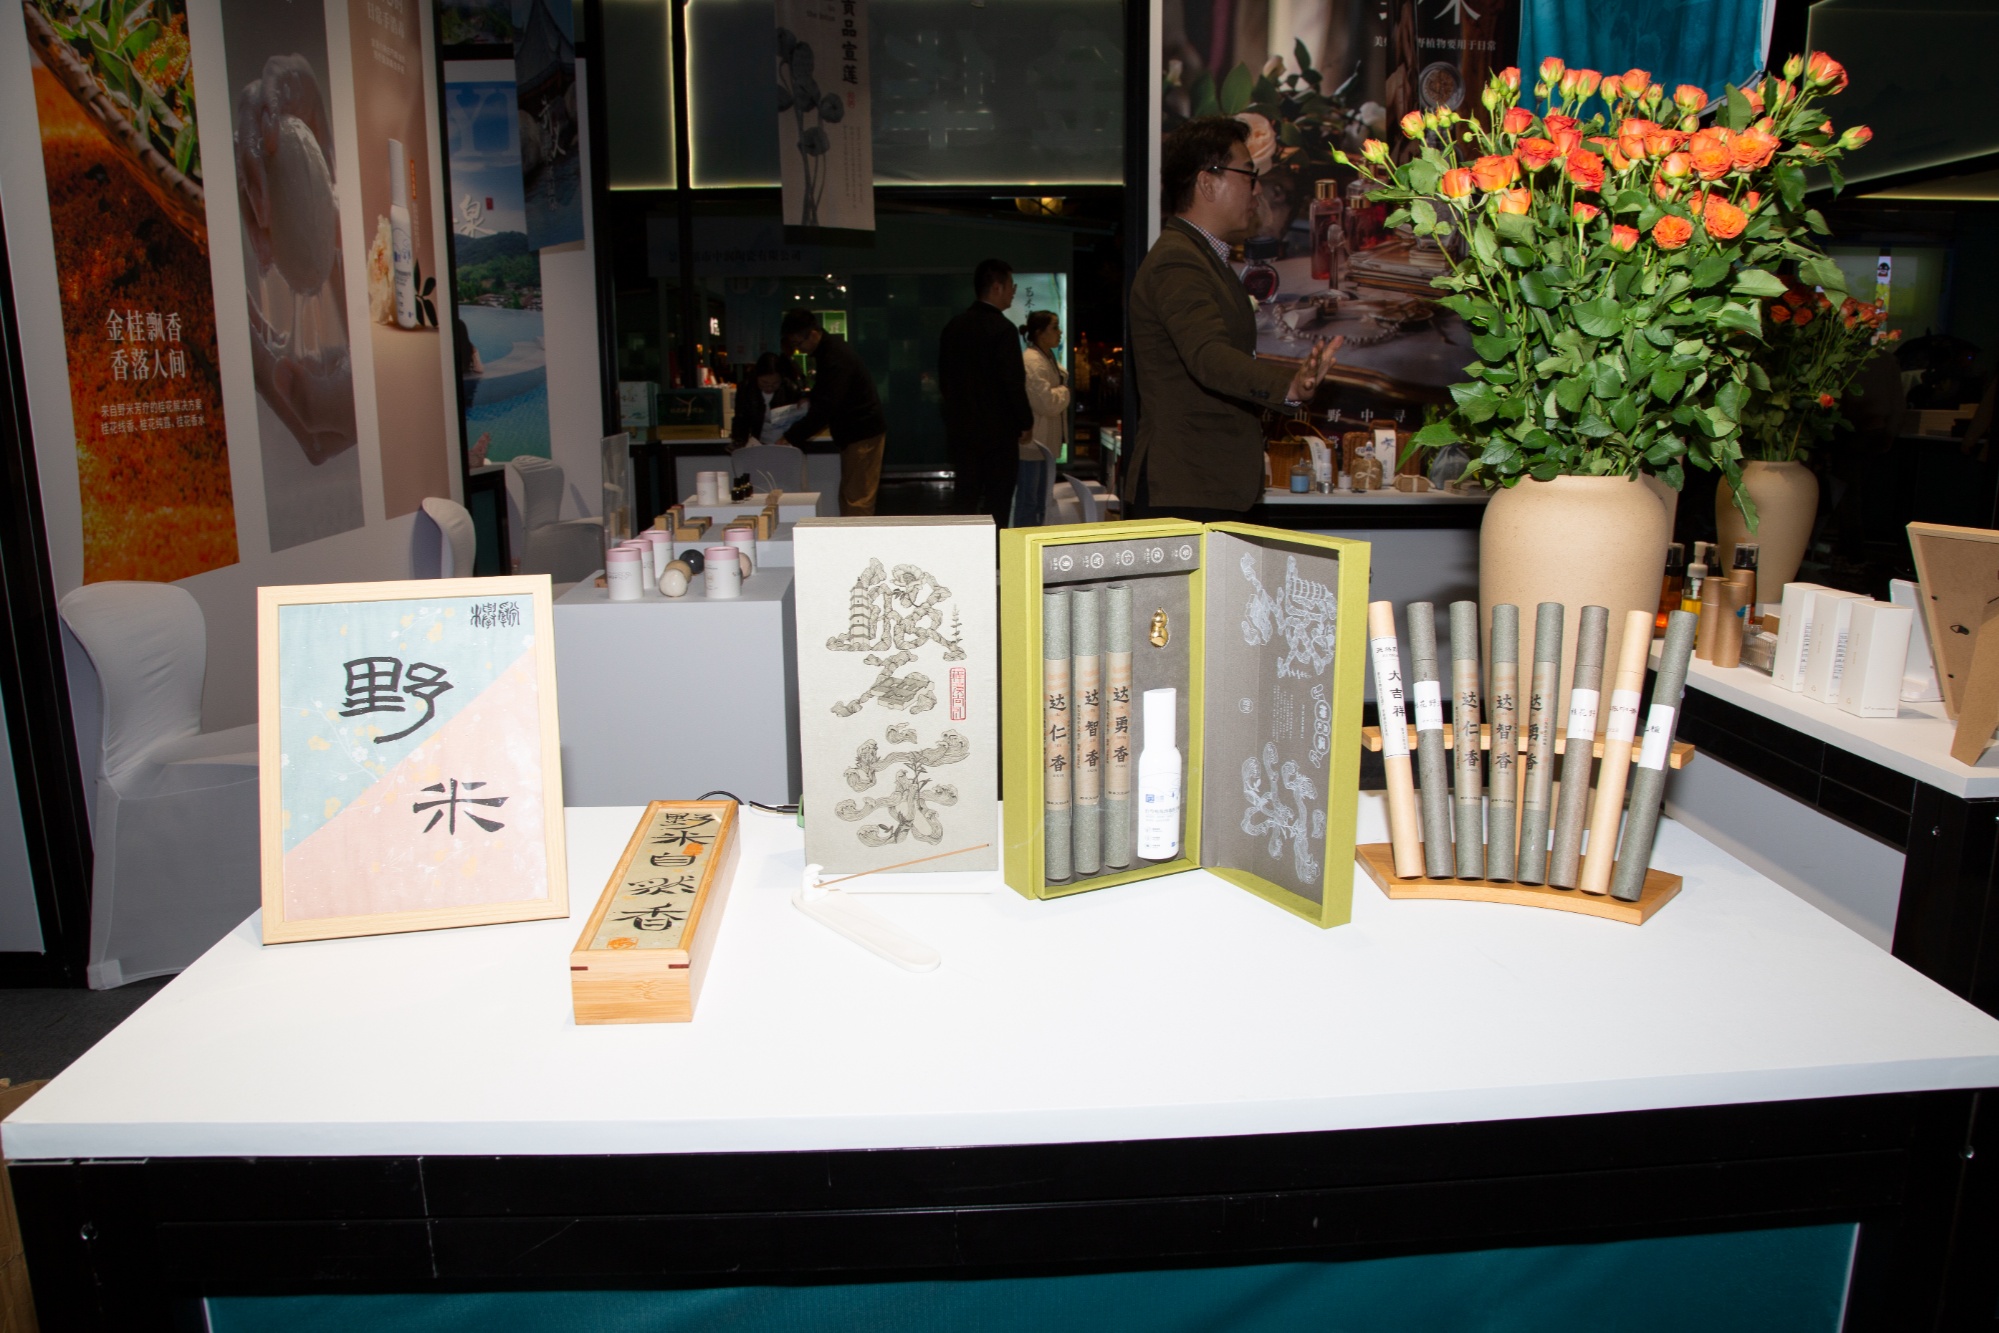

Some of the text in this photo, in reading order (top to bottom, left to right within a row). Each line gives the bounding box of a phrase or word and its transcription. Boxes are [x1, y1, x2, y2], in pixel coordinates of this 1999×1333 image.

[105, 308, 182, 342] 金桂飘香
[110, 348, 186, 380] 香落人间
[1084, 689, 1099, 768] 达智香
[1113, 686, 1130, 763] 达勇香
[1387, 669, 1406, 718] 大吉祥
[1461, 691, 1480, 767] 达仁香
[1495, 694, 1514, 769] 达智香
[1049, 693, 1067, 772] 达仁香
[1526, 694, 1543, 770] 达勇香
[412, 778, 510, 836] 米
[610, 812, 717, 932] 野米自然香
